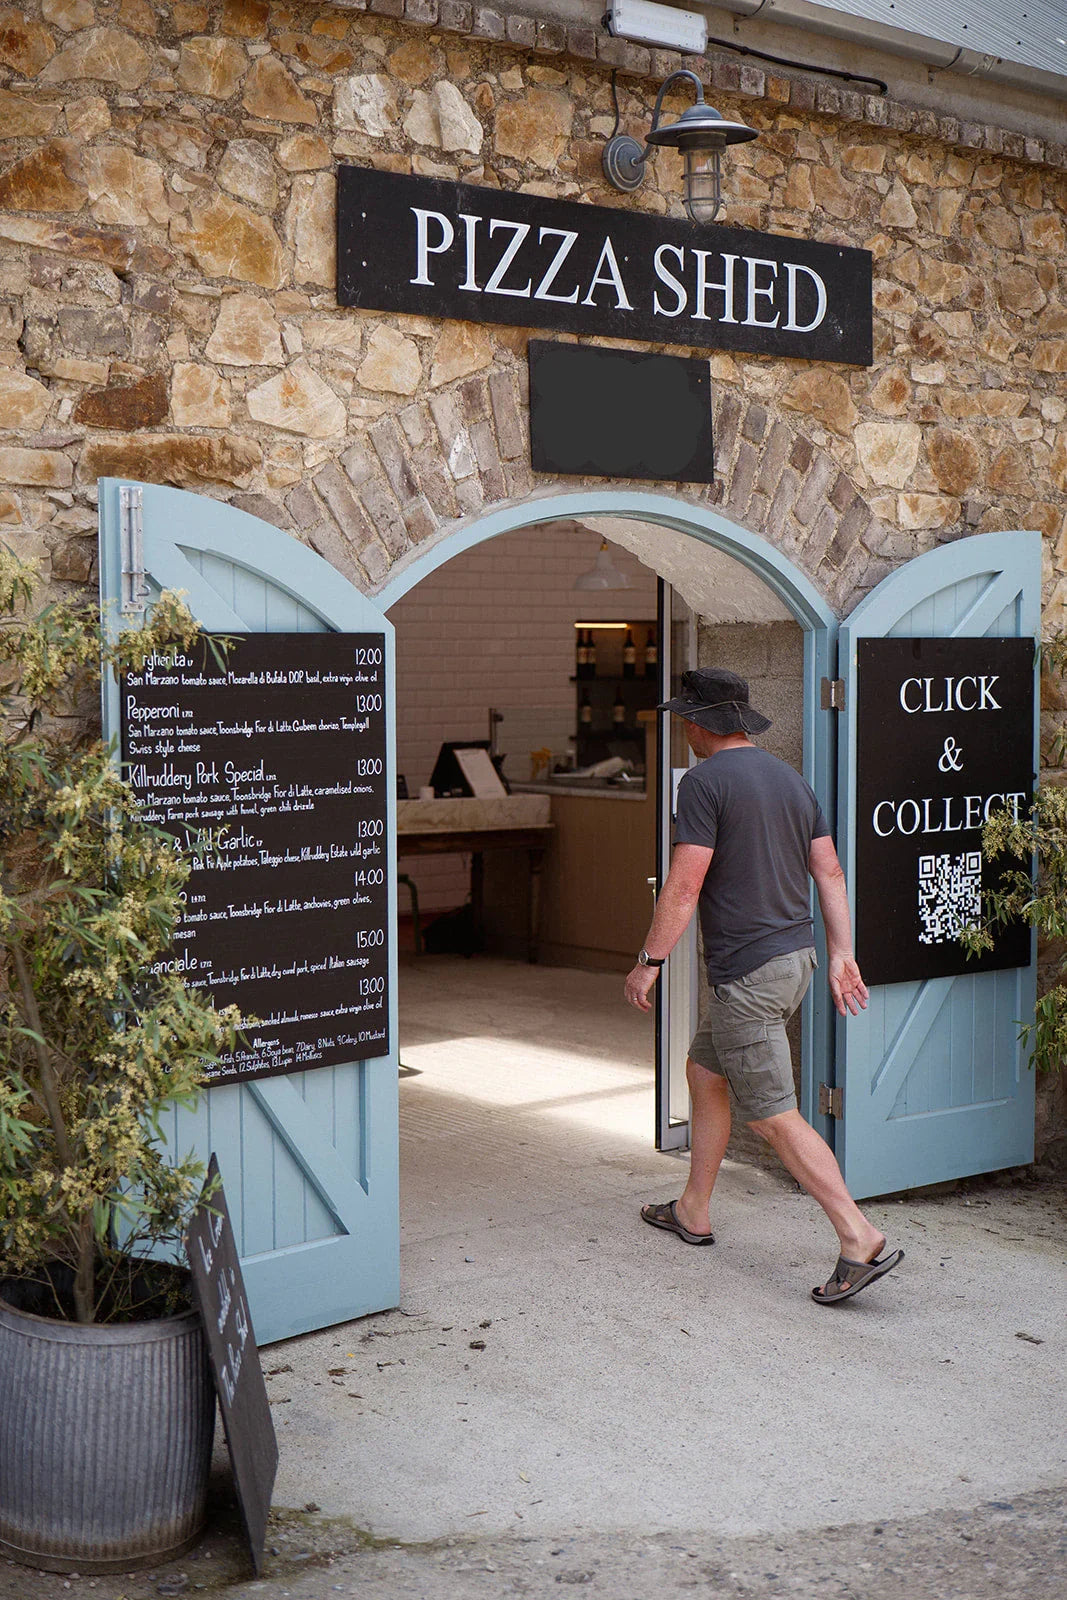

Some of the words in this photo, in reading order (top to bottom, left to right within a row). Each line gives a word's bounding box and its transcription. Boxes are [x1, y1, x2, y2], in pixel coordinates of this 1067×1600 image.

[409, 207, 634, 311] PIZZA
[652, 244, 828, 334] SHED
[127, 672, 143, 686] San
[145, 672, 180, 686] Marzano
[182, 672, 207, 686] tomato
[266, 670, 288, 684] Bufala
[322, 672, 338, 682] extra
[354, 670, 368, 682] olive
[370, 670, 378, 682] oil
[899, 676, 1002, 714] CLICK
[126, 694, 180, 722] Pepperoni
[128, 724, 142, 738] San
[143, 724, 174, 737] Marzano
[176, 723, 198, 736] tomato
[254, 720, 266, 733] Fior
[268, 720, 274, 732] di
[129, 740, 152, 754] Swiss
[154, 740, 174, 758] style
[177, 739, 201, 752] cheese
[938, 736, 964, 772] &
[128, 762, 192, 790] Killruddery
[196, 762, 220, 784] Pork
[224, 759, 264, 786] Special
[147, 792, 182, 807] Marzano
[182, 792, 208, 804] tomato
[273, 784, 288, 798] Fior
[288, 784, 296, 798] di
[168, 808, 184, 820] Farm
[184, 806, 200, 822] pork
[201, 810, 224, 820] sausage
[226, 804, 238, 816] with
[260, 806, 278, 817] green
[292, 798, 315, 811] drizzle
[173, 838, 182, 852] &
[217, 825, 255, 850] Garlic
[192, 856, 205, 870] Pink
[330, 844, 348, 858] Estate
[350, 842, 362, 857] wild
[362, 840, 381, 860] garlic
[184, 908, 208, 923] tomato
[264, 900, 276, 914] Fior
[333, 898, 351, 910] green
[271, 964, 282, 979] dry
[310, 957, 327, 974] spiced
[346, 958, 370, 968] sausage
[362, 998, 374, 1010] olive
[375, 995, 383, 1008] oil
